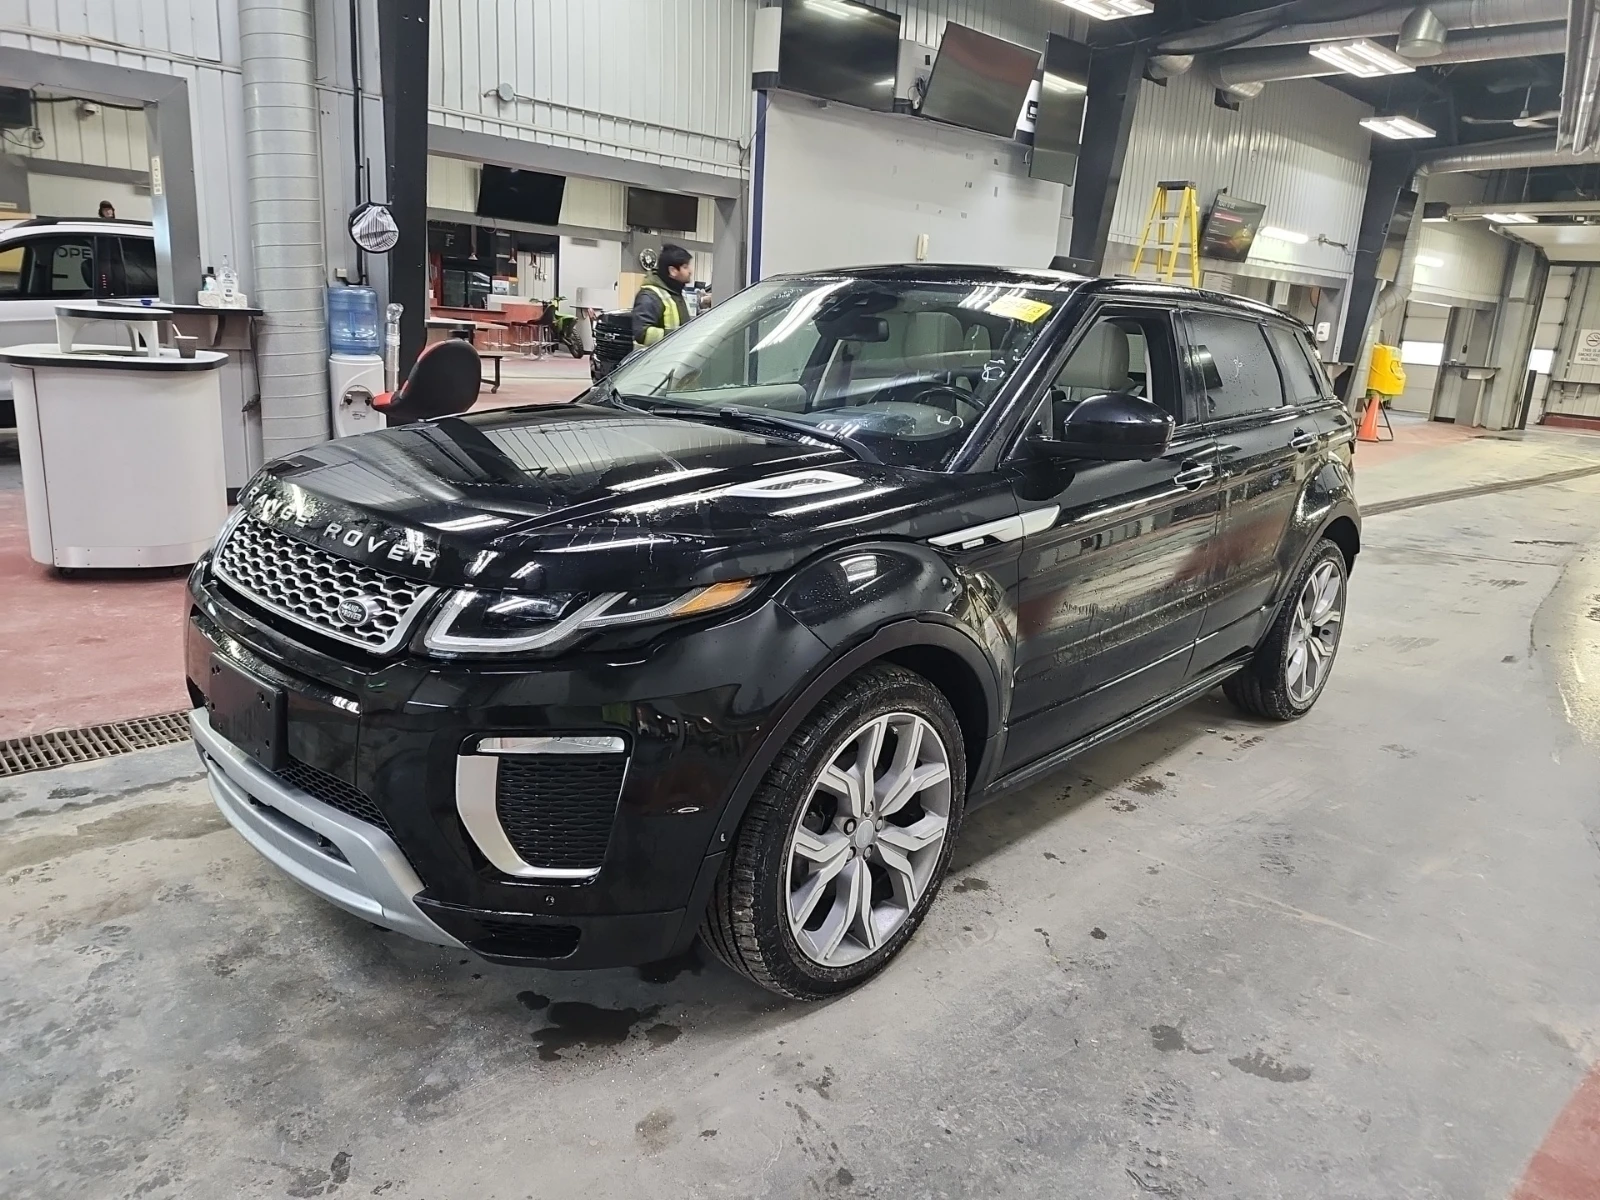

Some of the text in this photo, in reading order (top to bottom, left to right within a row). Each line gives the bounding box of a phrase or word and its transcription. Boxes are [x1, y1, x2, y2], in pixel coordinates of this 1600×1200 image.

[247, 485, 437, 569] RANGE ROVER
[341, 602, 359, 612] LAND
[342, 609, 362, 621] ROVER
